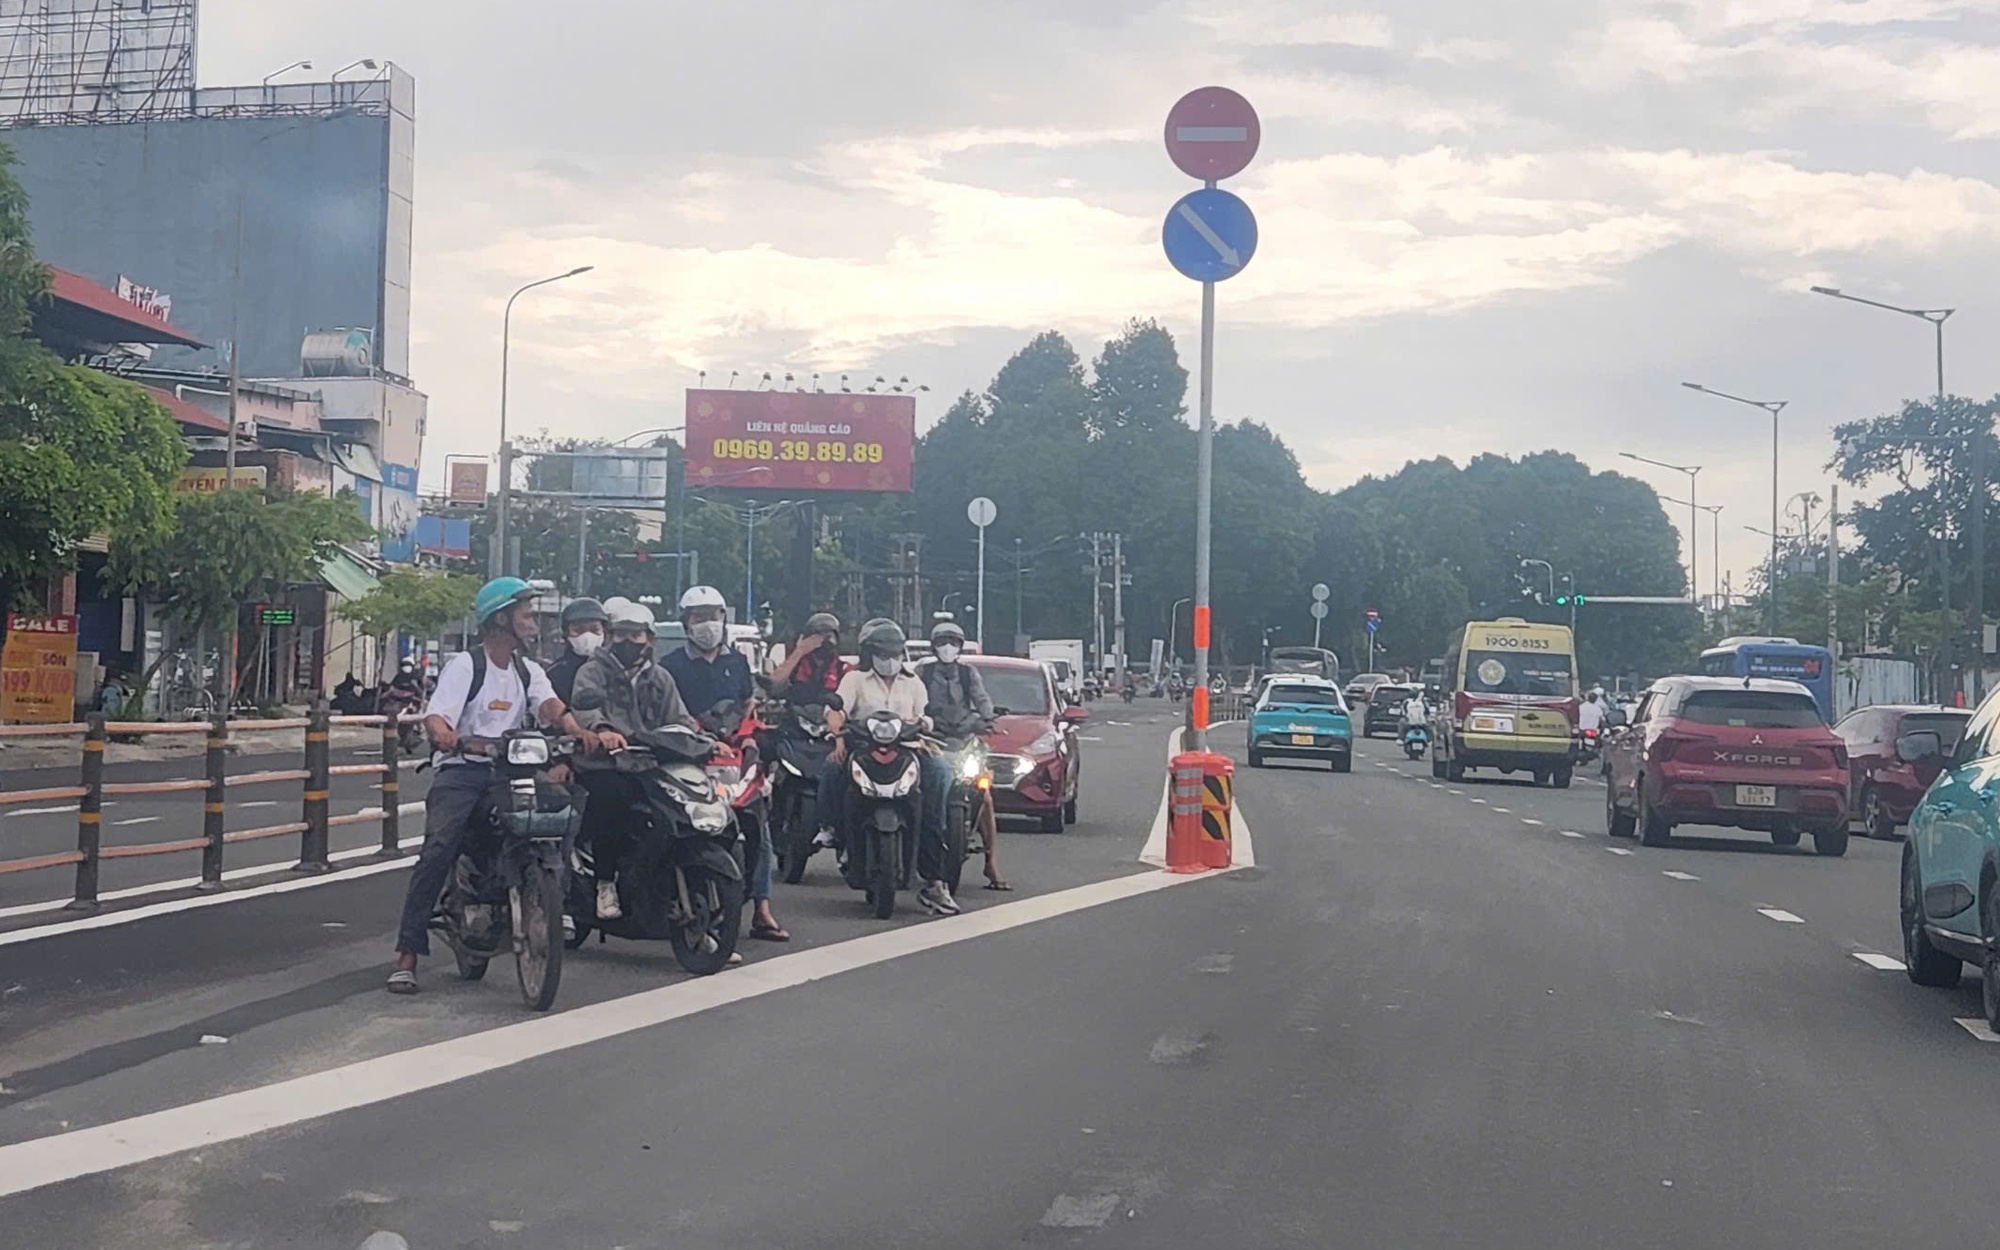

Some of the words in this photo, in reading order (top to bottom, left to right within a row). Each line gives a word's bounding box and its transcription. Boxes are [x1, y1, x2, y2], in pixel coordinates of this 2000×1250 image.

[747, 421, 771, 432] LIÊN
[713, 438, 883, 463] 0969.39.89.89
[13, 618, 69, 631] SALE
[1485, 637, 1518, 647] 1900
[1521, 639, 1549, 649] 8153
